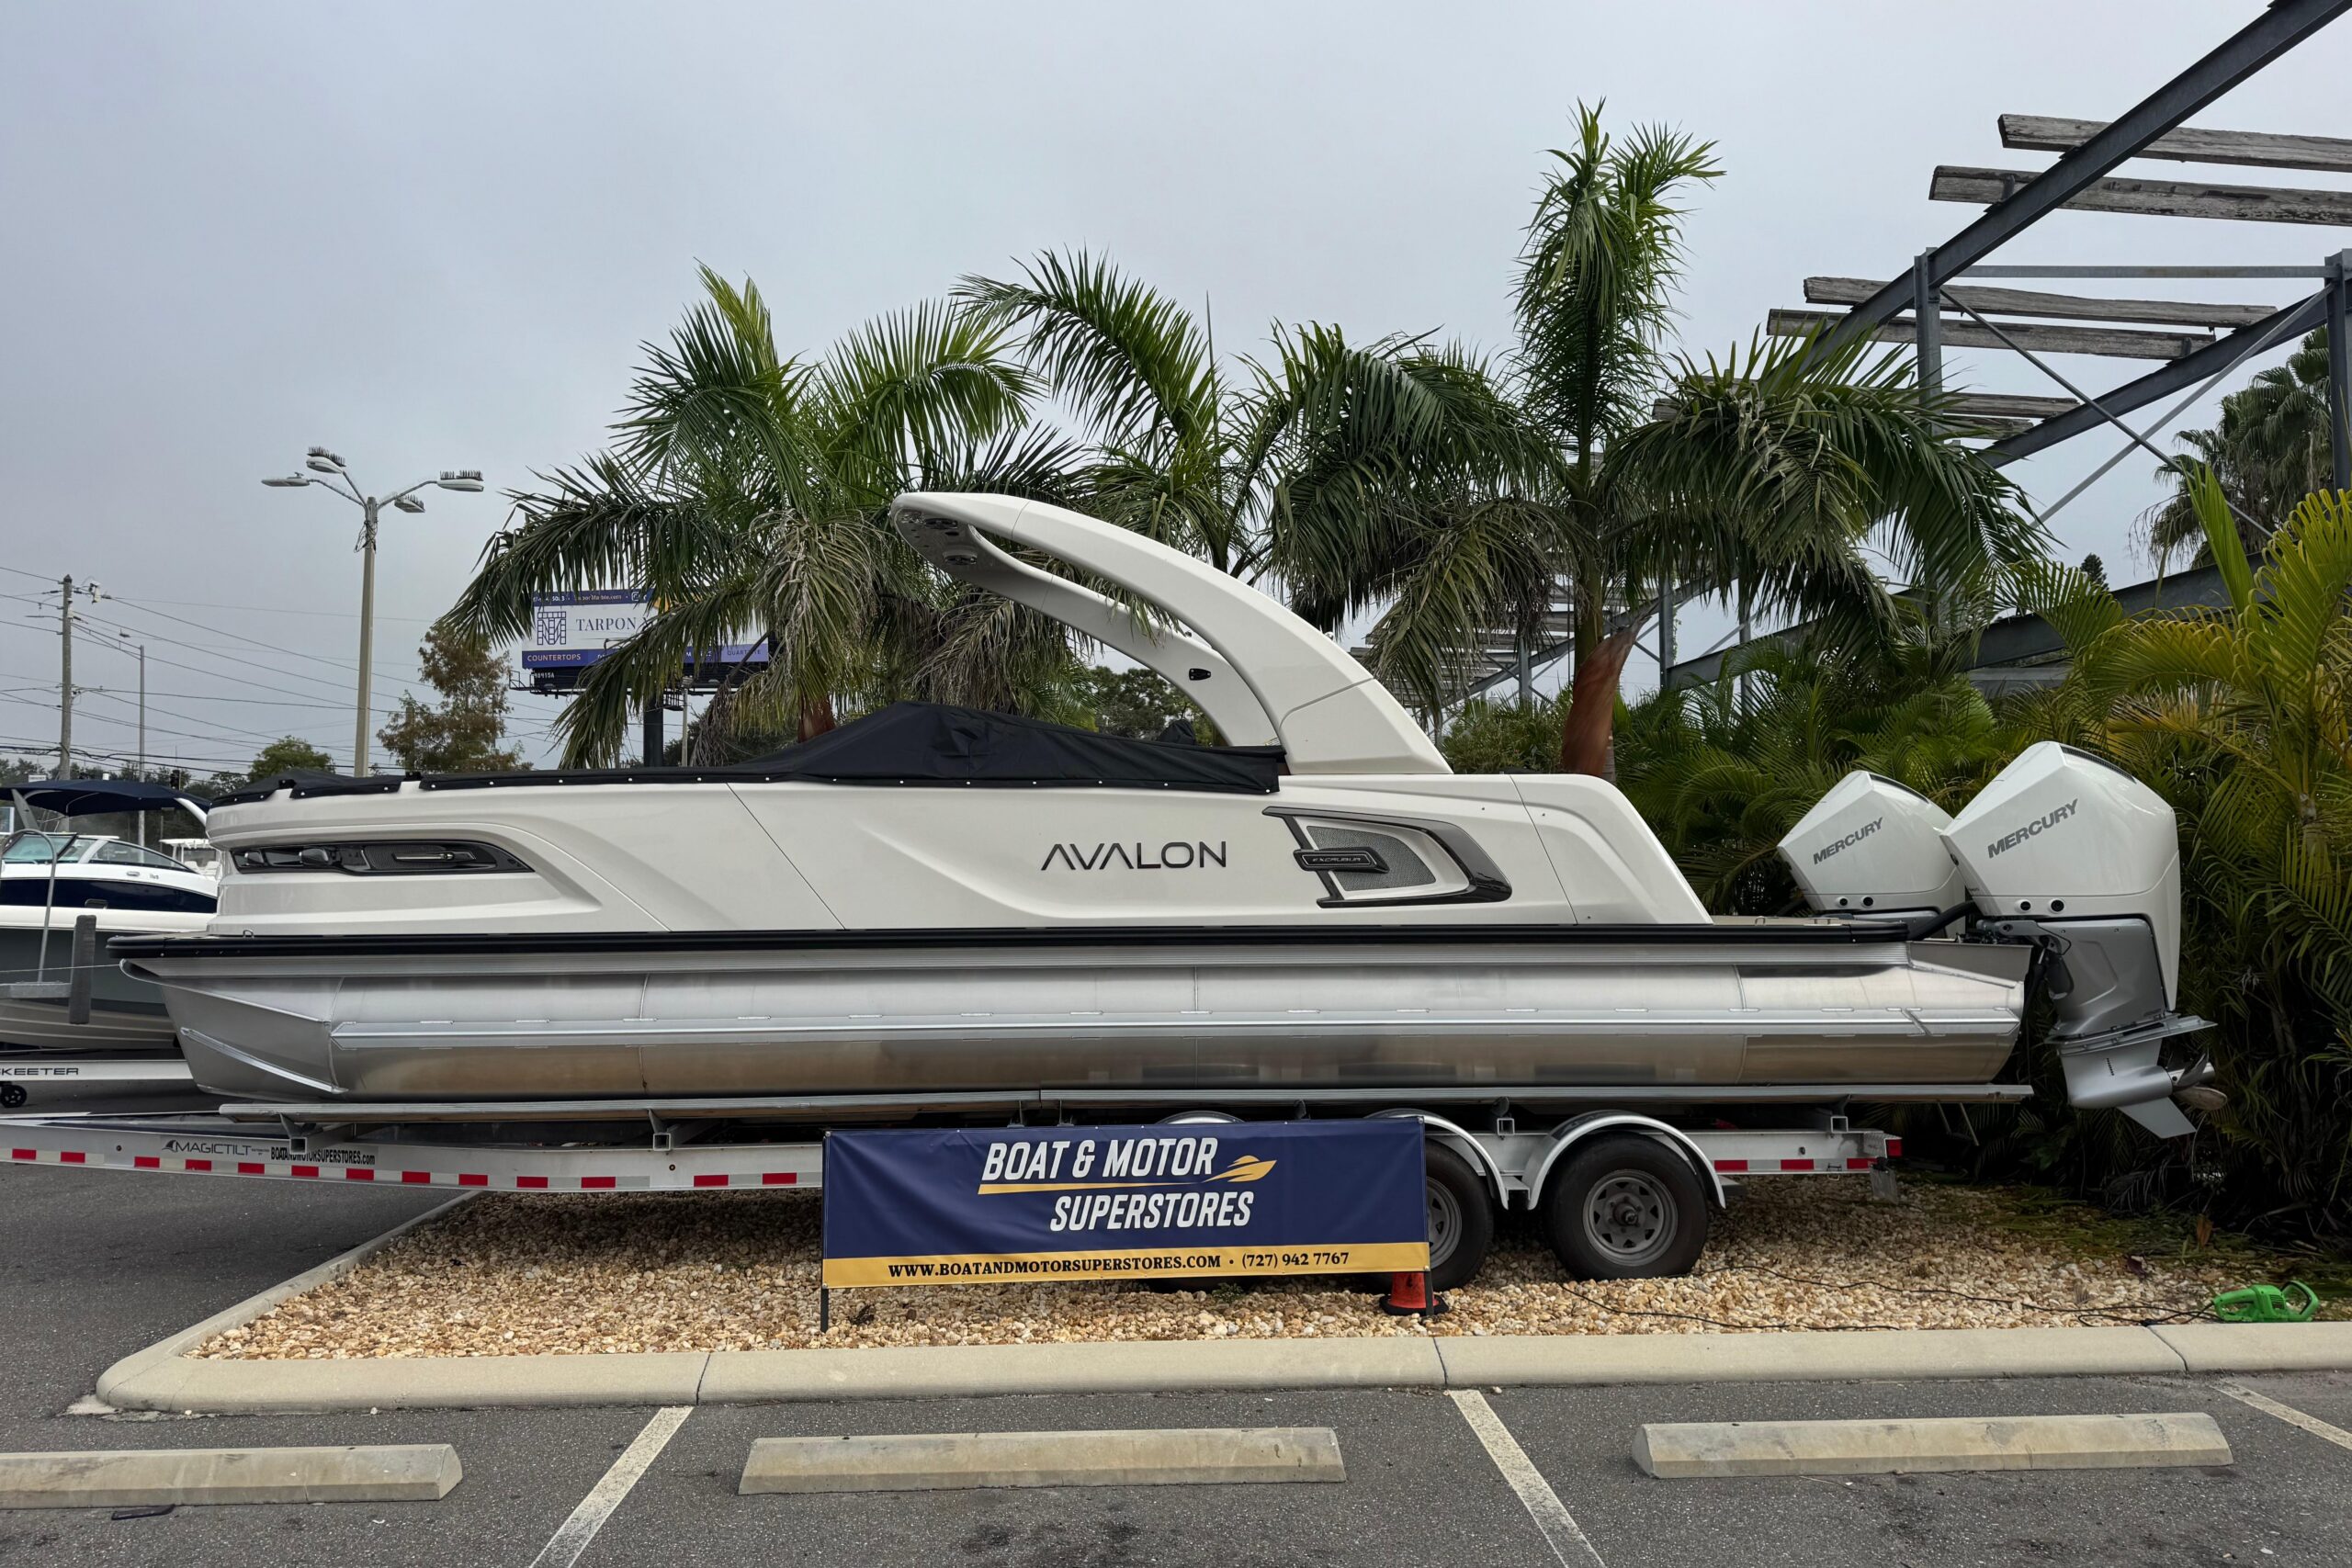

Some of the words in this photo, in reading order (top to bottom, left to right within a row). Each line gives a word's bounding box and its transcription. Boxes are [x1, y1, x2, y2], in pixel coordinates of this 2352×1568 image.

[576, 616, 637, 631] TARPON
[526, 653, 582, 662] COUNTERTOPS
[1813, 816, 1883, 865] MERCURY
[1987, 798, 2079, 859] MERCURY
[1040, 840, 1227, 871] AVALON
[0, 1067, 79, 1076] KEETER
[175, 1141, 252, 1156] MAGICTILT
[981, 1140, 1071, 1181] BOAT
[1071, 1139, 1096, 1179] &
[1102, 1137, 1219, 1178] MOTOR
[1050, 1190, 1255, 1233] SUPERSTORES
[888, 1255, 1221, 1278] WWW.BOATANDMOTORSUPERSTORES.COM
[1241, 1252, 1279, 1269] (727)
[1282, 1253, 1310, 1267] 942
[1313, 1251, 1350, 1265] 7767
